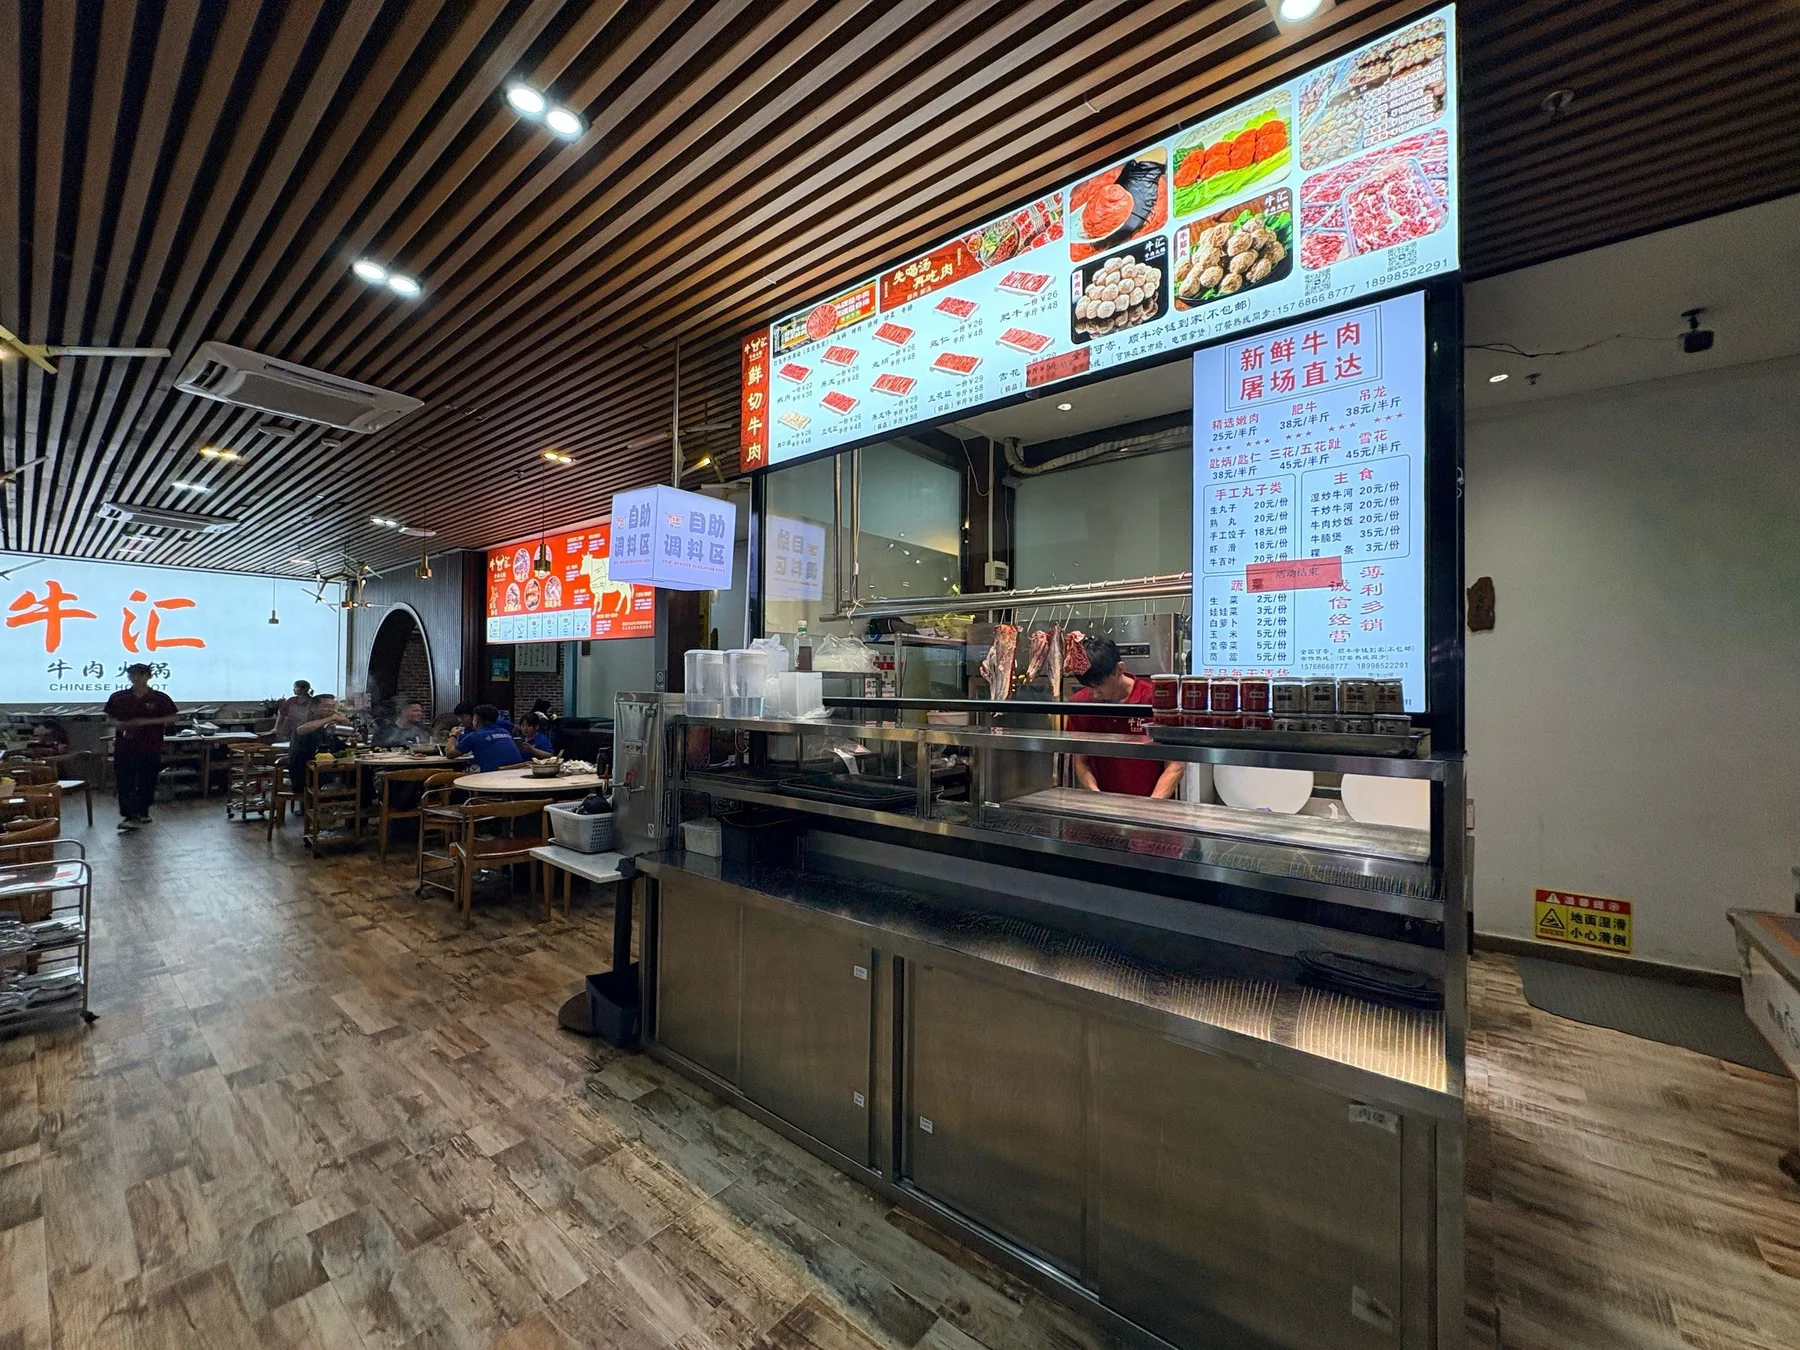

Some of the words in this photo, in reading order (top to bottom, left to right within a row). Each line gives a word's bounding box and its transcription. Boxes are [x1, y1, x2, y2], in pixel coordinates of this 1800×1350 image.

[892, 257, 932, 286] 先喝汤
[912, 263, 953, 290] 再吃肉
[1298, 294, 1325, 310] 6866
[1327, 284, 1356, 301] 8777
[1364, 258, 1449, 289] 18998522291
[1240, 321, 1361, 372] 新鲜牛肉
[1240, 353, 1363, 401] 屠场直达
[746, 363, 764, 462] 鲜切牛肉
[1212, 412, 1260, 431] 精选嫩肉
[1291, 401, 1318, 416] 肥牛
[1359, 385, 1387, 402] 吊龙
[1212, 426, 1258, 442] 25元/半斤
[1280, 411, 1330, 430] 38元/半斤
[1345, 396, 1402, 417] 38元/半斤
[1269, 437, 1342, 460] 三花/五花趾
[1359, 429, 1388, 445] 雪花
[1212, 465, 1258, 480] 38元/半斤
[1280, 454, 1330, 470] 45元/半斤
[1345, 441, 1402, 459] 45元/半斤
[1215, 481, 1282, 501] 手工丸子类
[1310, 488, 1354, 503] 湿炒牛河
[1359, 481, 1400, 496] 20元/份
[629, 502, 651, 530] 自助
[1209, 503, 1237, 515] 生丸子
[1253, 497, 1289, 510] 20元/份
[1310, 502, 1354, 517] 干炒牛河
[1359, 496, 1400, 510] 20元/份
[689, 510, 726, 539] 自助
[1253, 511, 1289, 523] 20元/份
[1310, 516, 1354, 531] 牛肉炒饭
[1359, 510, 1400, 524] 20元/份
[1209, 529, 1247, 541] 手工饺子
[1254, 525, 1288, 536] 18元/份
[1310, 532, 1342, 544] 牛腩煲
[1359, 525, 1401, 538] 35元/份
[614, 532, 651, 558] 调料区
[664, 533, 725, 565] 调料区
[1254, 538, 1288, 550] 18元/份
[1365, 540, 1400, 553] 3元/份
[1209, 556, 1236, 567] 牛百叶
[1253, 552, 1288, 563] 20元/份
[1256, 593, 1287, 603] 2元/份
[1359, 565, 1385, 632] 薄利多销
[5, 580, 206, 654] 牛汇
[1209, 607, 1238, 617] 娃娃菜
[1256, 604, 1287, 615] 3元/份
[1328, 580, 1352, 644] 诚信经营
[1209, 618, 1238, 628] 白萝卜
[1256, 616, 1287, 627] 2元/份
[1256, 628, 1287, 638] 5元/份
[1209, 641, 1238, 651] 皇帝菜
[1256, 640, 1287, 650] 5元/份
[1256, 652, 1287, 662] 5元/份
[49, 683, 111, 691] CHINESE
[1570, 911, 1626, 931] 地面湿滑
[1570, 927, 1626, 947] 小心滑倒
